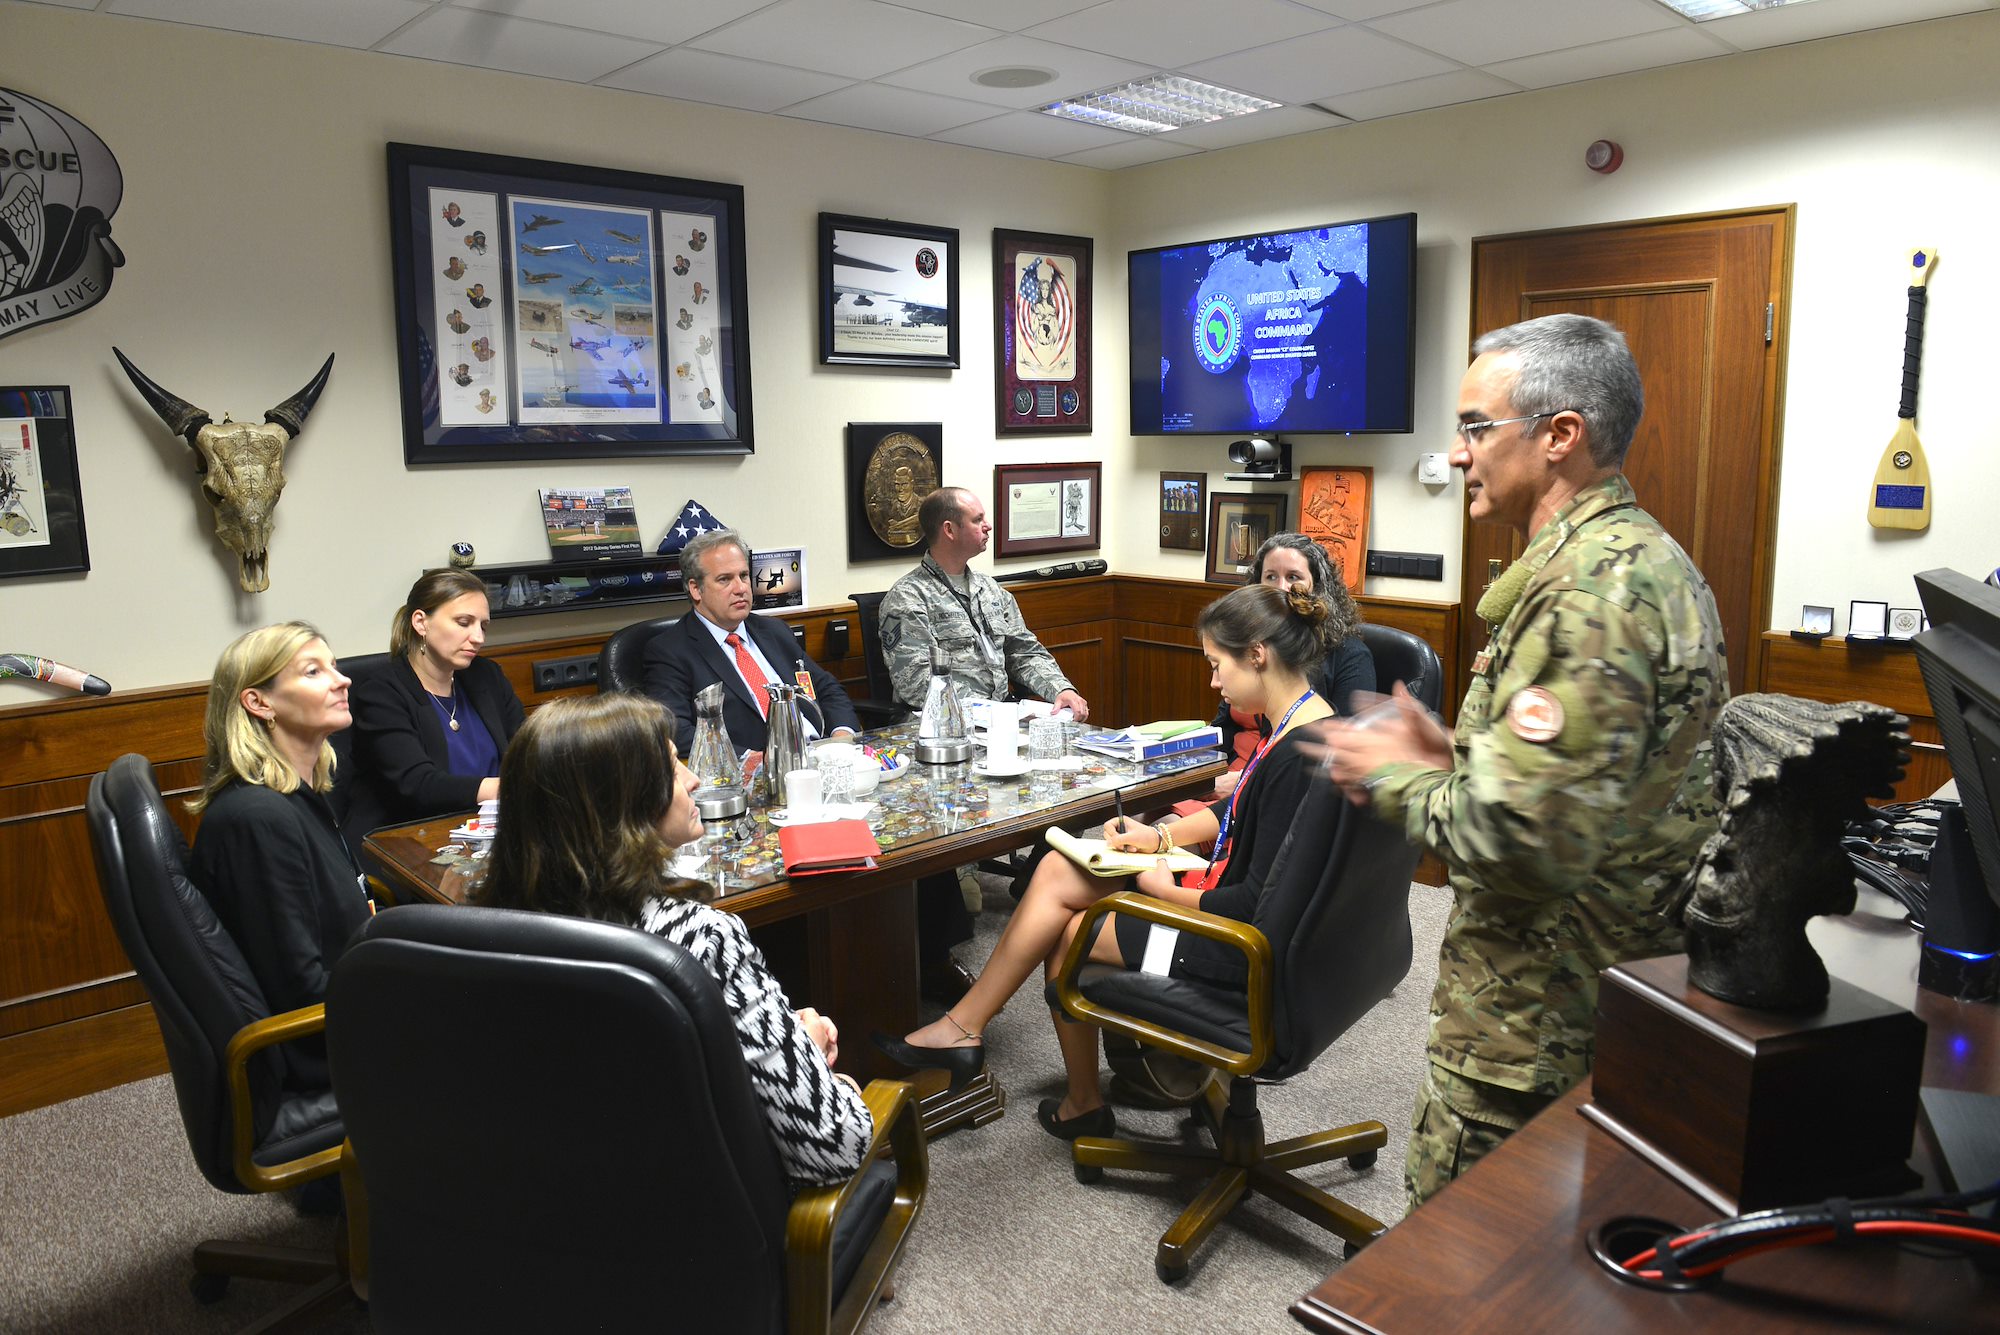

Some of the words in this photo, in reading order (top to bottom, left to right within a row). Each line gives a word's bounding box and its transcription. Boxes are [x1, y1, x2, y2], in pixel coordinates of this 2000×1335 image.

[0, 299, 41, 328] MAY
[52, 276, 99, 309] LIVE
[1214, 293, 1237, 312] AFRICA
[1247, 291, 1285, 305] UNITED
[1286, 287, 1322, 302] STATES
[1195, 296, 1213, 324] STATES
[1265, 307, 1302, 320] AFRICA
[1194, 325, 1204, 358] UNITED
[1232, 311, 1242, 357] COMMAND
[1255, 324, 1314, 338] COMMAND
